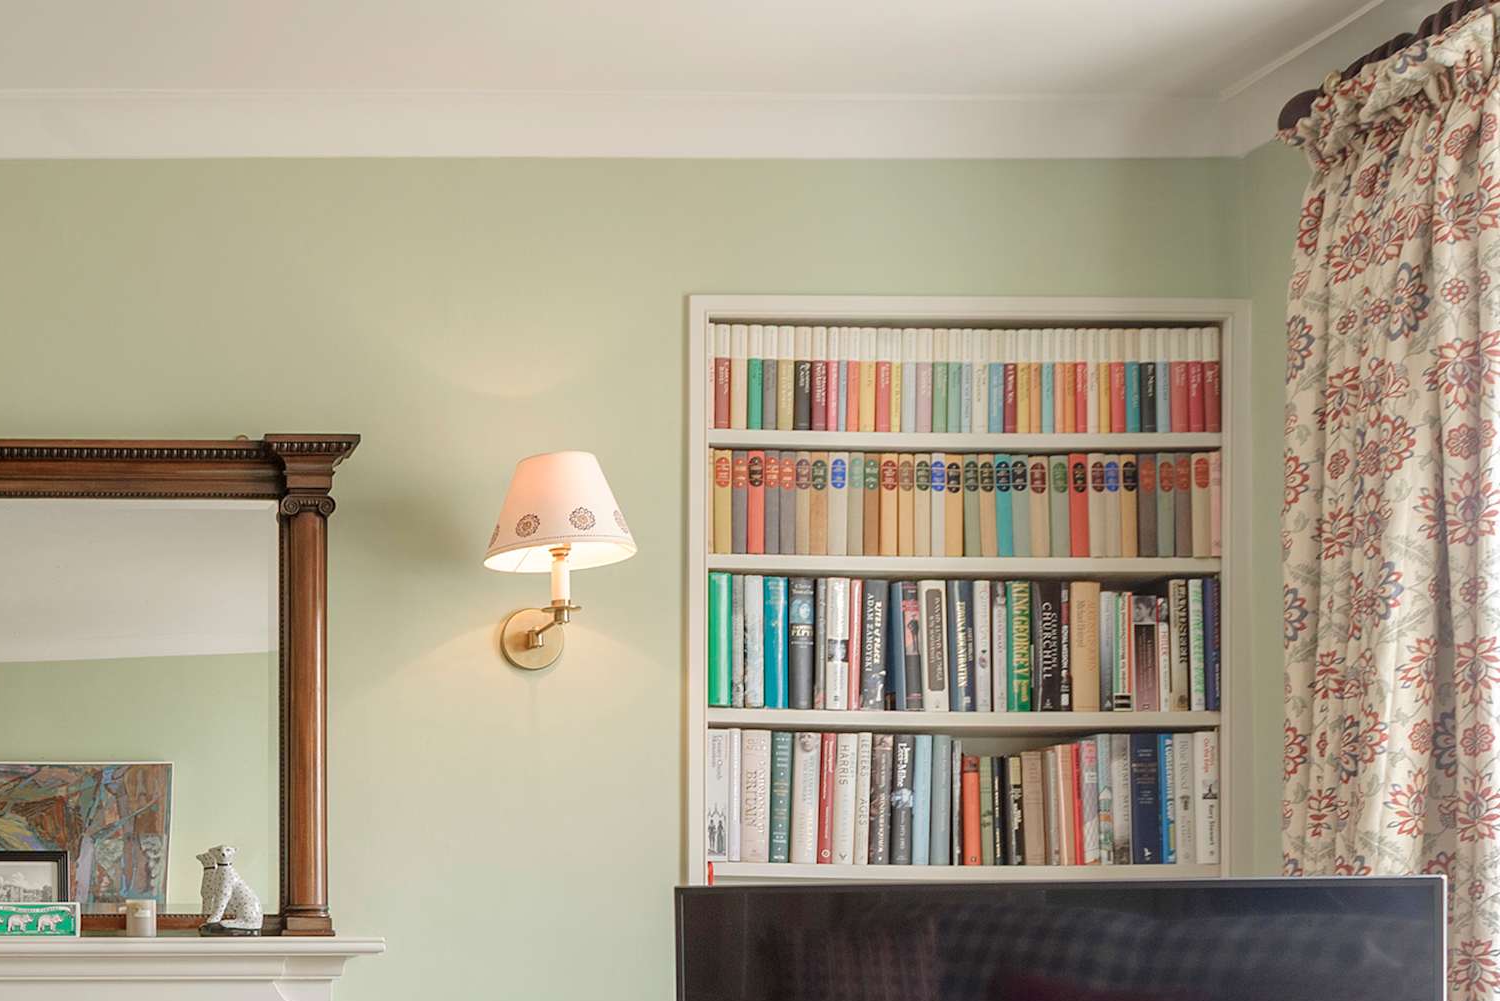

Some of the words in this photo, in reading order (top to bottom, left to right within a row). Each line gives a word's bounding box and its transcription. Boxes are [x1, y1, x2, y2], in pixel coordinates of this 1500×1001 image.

[866, 593, 875, 621] ADAM
[1012, 582, 1030, 615] KING
[1012, 617, 1030, 666] GEORGE
[1042, 602, 1053, 680] CHURCHILL
[1177, 583, 1189, 664] LANDSEER
[864, 623, 874, 672] ZAMOYSKI
[838, 744, 850, 786] HARRIS
[859, 738, 871, 777] LETTERS
[858, 798, 868, 826] AGES
[1208, 820, 1217, 846] Stewart
